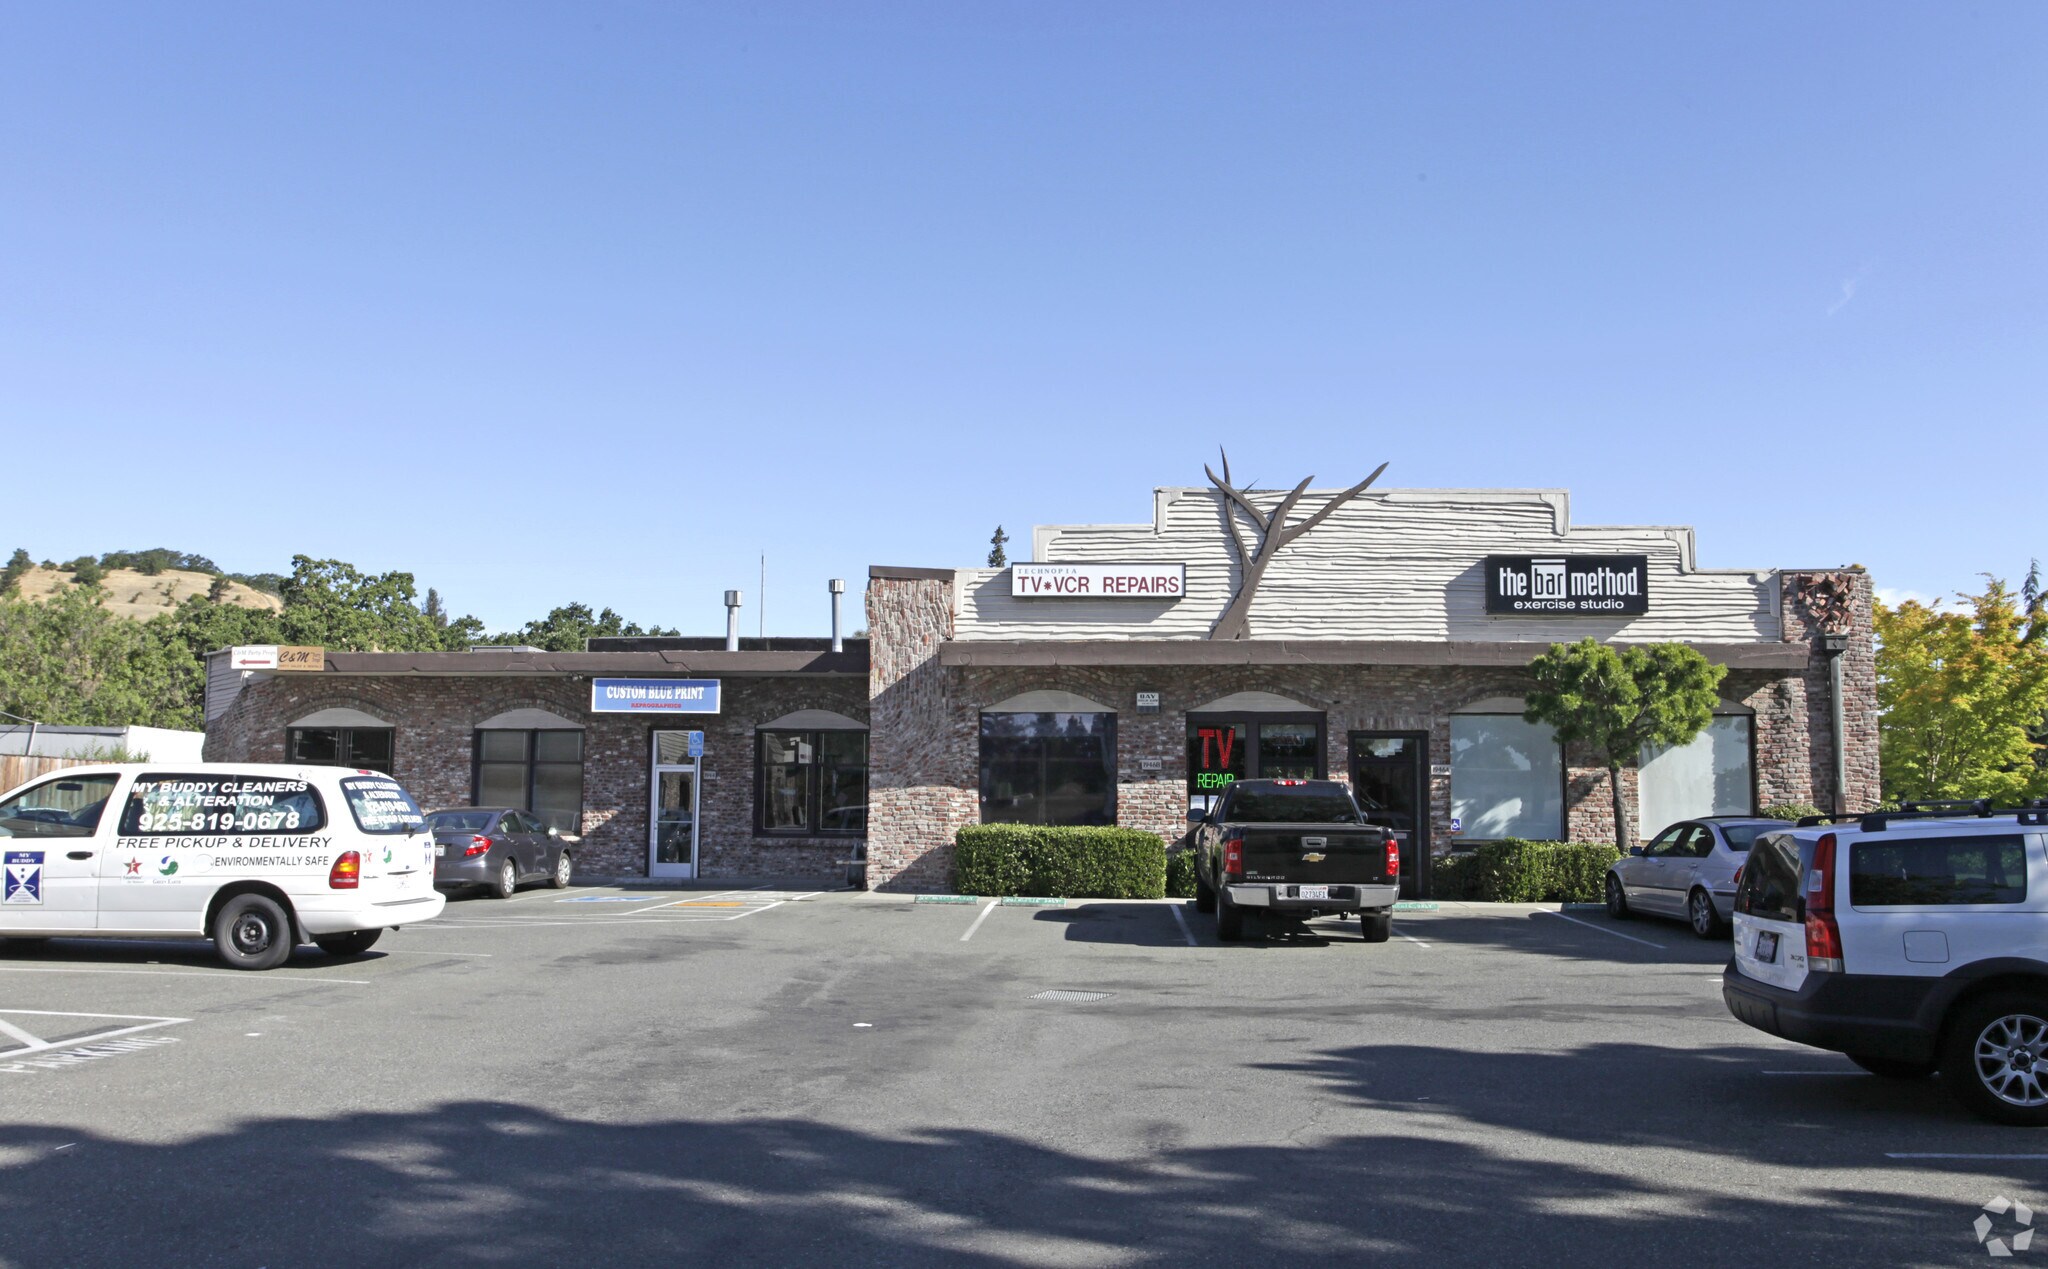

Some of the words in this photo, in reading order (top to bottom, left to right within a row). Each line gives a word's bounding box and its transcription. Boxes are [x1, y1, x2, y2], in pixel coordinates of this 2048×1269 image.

[1102, 576, 1179, 593] REPAIRS
[1500, 567, 1527, 596] the
[1534, 568, 1564, 596] bar
[1570, 566, 1638, 596] method
[1514, 599, 1576, 609] exercise
[1580, 599, 1624, 609] studio
[278, 650, 310, 662] C&M
[606, 686, 646, 699] CUSTOM
[648, 686, 673, 699] BLUE
[675, 686, 704, 700] PRINT
[1198, 728, 1235, 769] TV
[131, 782, 157, 793] MY
[160, 782, 218, 793] BUDDY
[220, 782, 308, 792] CLEANERS
[158, 796, 170, 807] &
[174, 796, 274, 807] ALTERATION
[138, 812, 300, 832] 925-819-0678
[116, 838, 160, 848] FREE
[164, 838, 228, 848] PICKUP
[232, 838, 243, 848] &
[249, 837, 332, 848] DELIVERY
[214, 856, 302, 866] ENVIRONMENTALLY
[304, 856, 329, 866] SAFE
